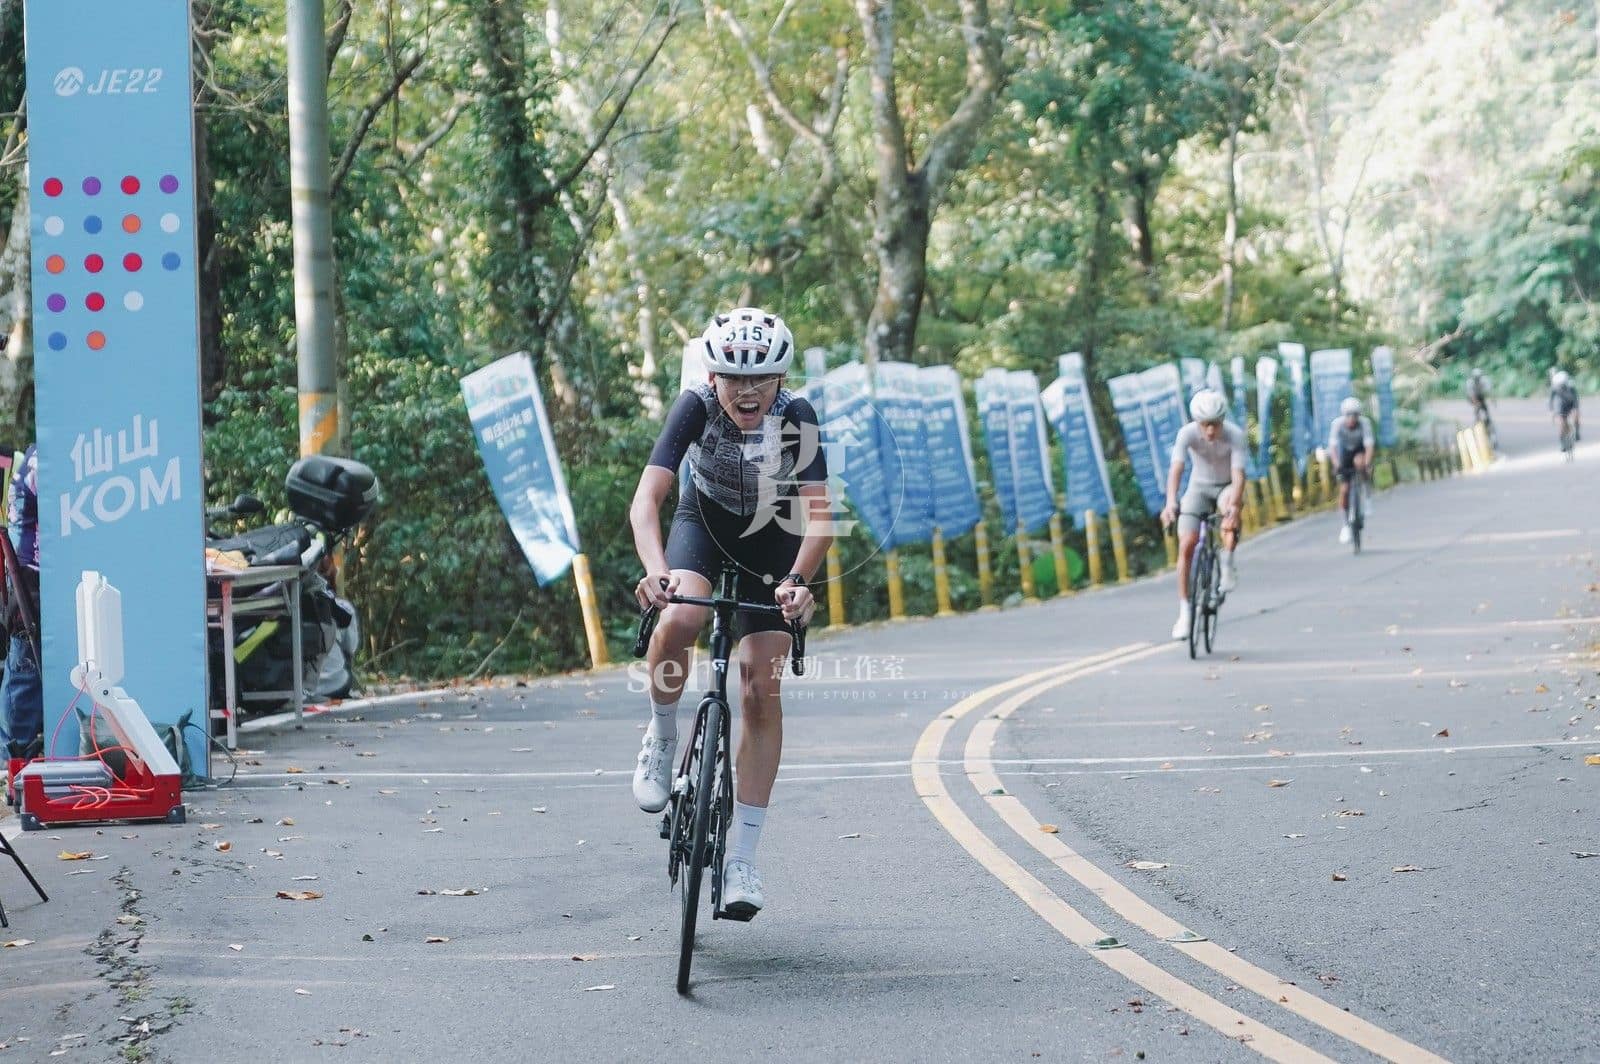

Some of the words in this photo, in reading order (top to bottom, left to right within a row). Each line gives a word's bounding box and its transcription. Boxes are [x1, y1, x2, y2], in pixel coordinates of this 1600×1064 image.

[87, 67, 163, 95] JE22
[70, 413, 158, 482] 仙山
[58, 456, 182, 537] KOM
